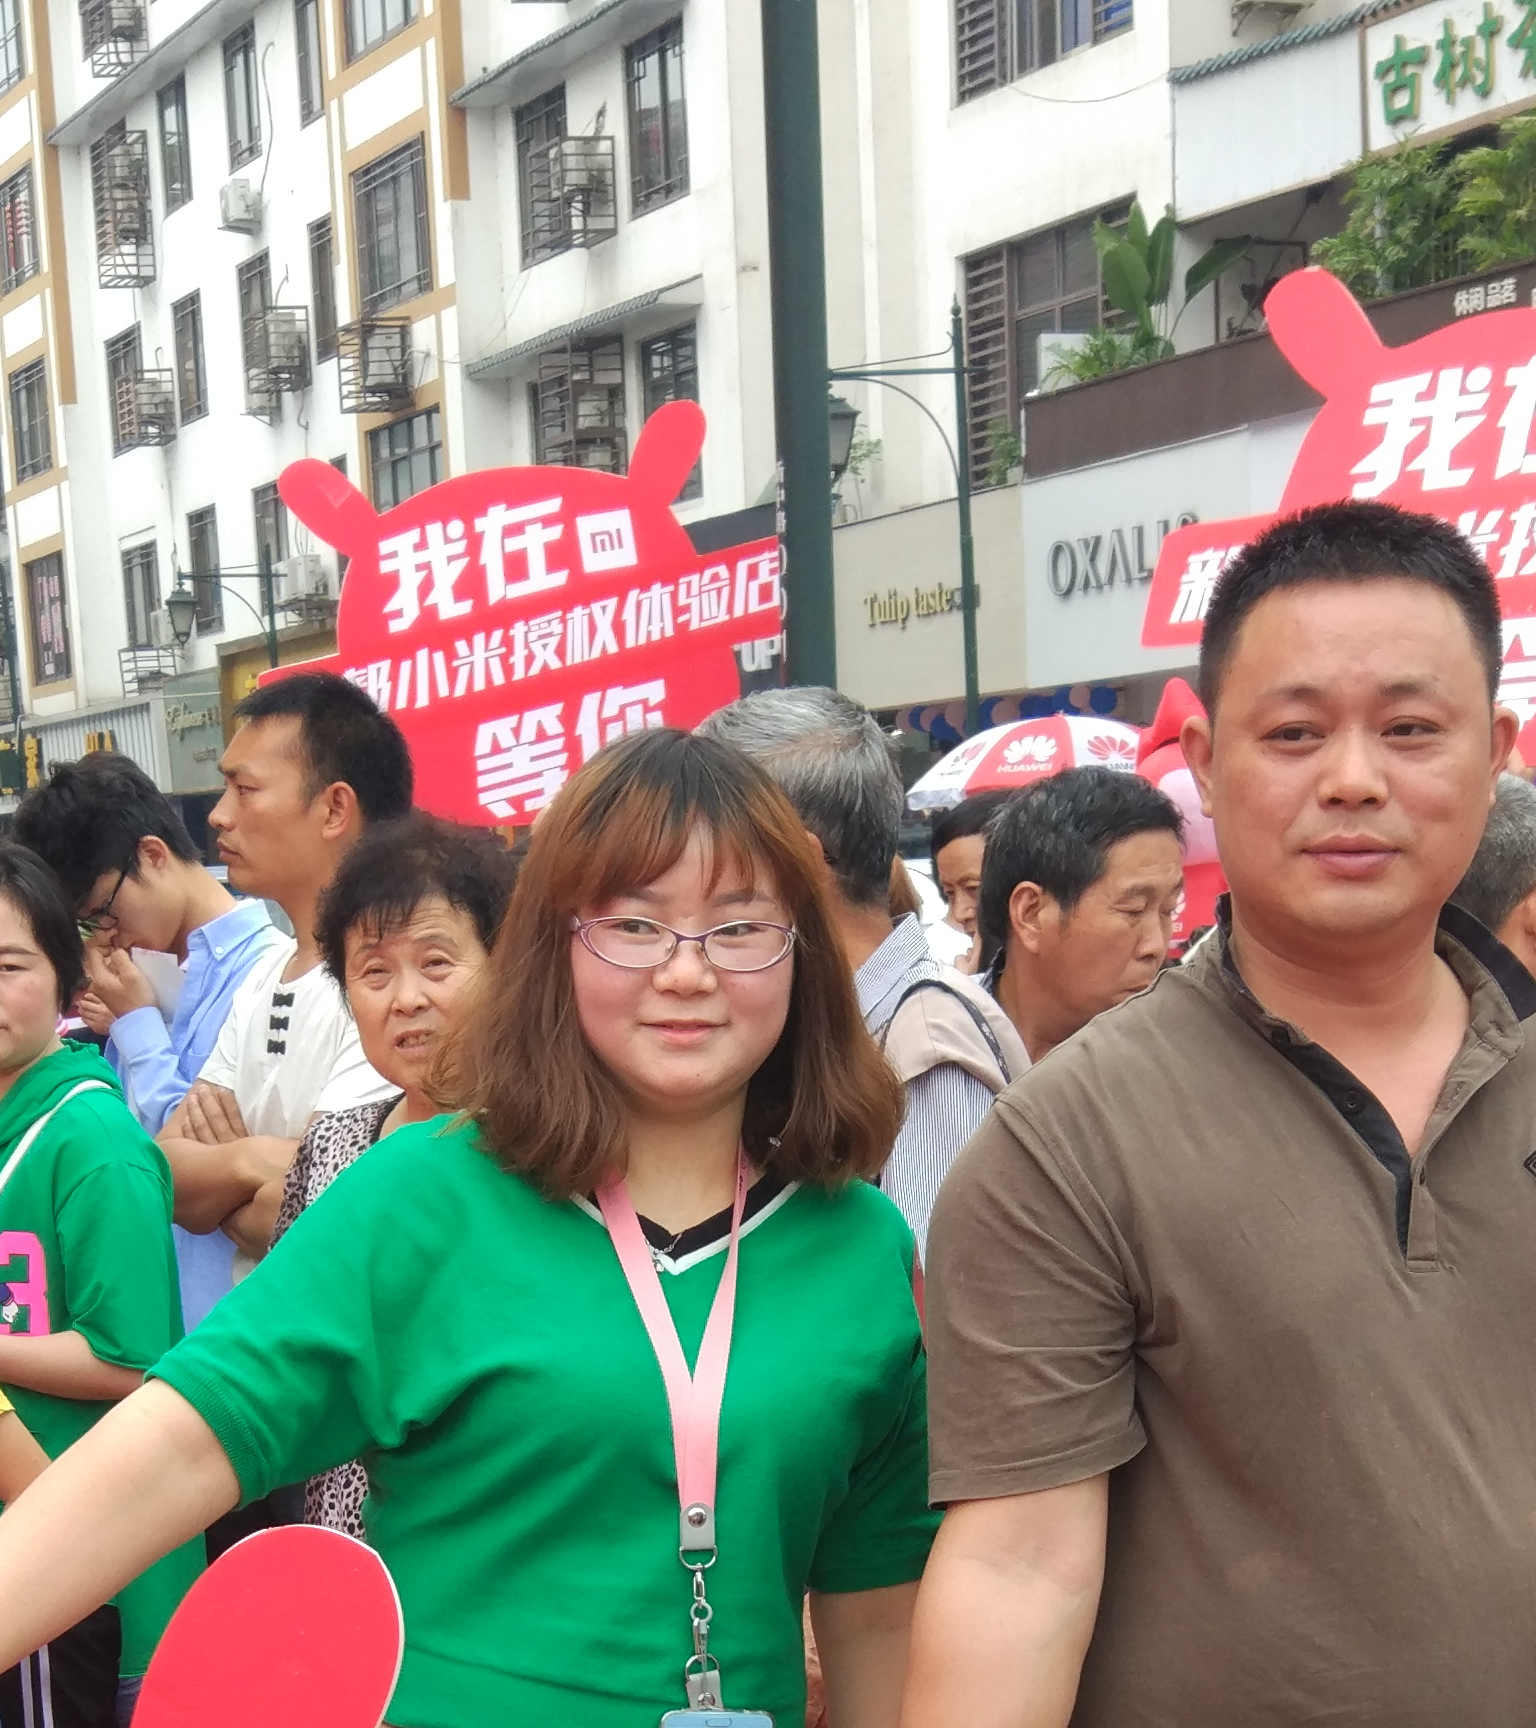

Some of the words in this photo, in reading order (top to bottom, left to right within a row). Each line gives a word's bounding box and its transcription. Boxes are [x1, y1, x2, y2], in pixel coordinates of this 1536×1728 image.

[343, 547, 781, 713] 都小米授权体验店
[377, 496, 571, 635] 我在
[997, 763, 1054, 774] HUAWEI
